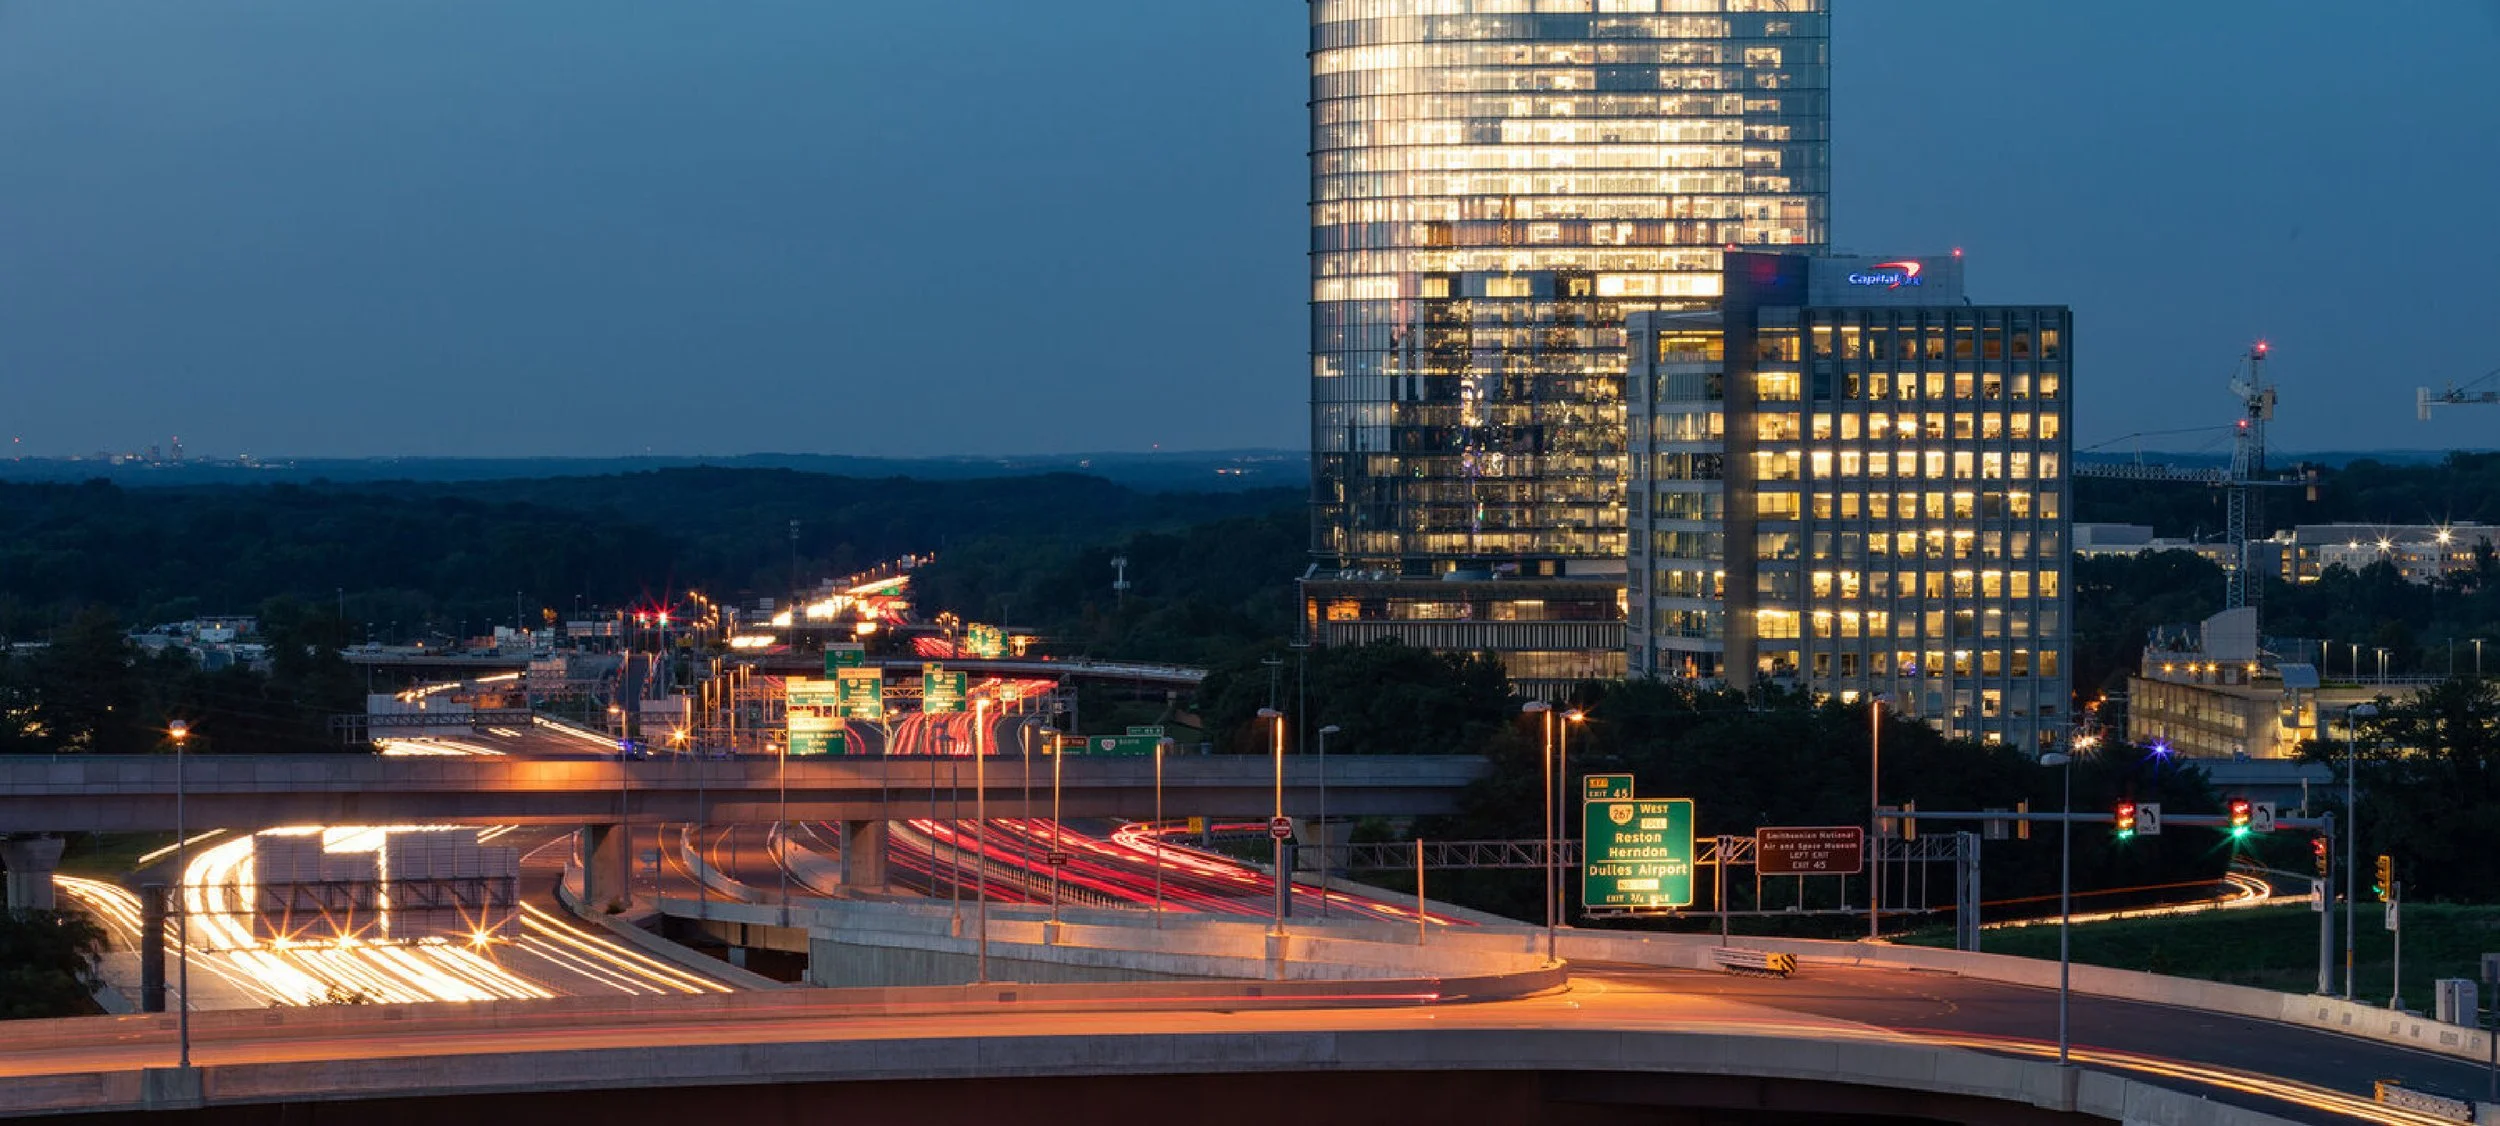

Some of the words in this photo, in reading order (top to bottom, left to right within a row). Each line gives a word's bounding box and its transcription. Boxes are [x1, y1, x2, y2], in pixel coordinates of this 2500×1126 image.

[1849, 273, 1899, 285] Capital
[1613, 809, 1631, 820] 267
[1615, 833, 1662, 843] Reston
[1609, 846, 1668, 857] Herndon
[1790, 851, 1809, 859] LEFT
[1589, 864, 1632, 876] Dulles
[1638, 863, 1687, 877] Airport
[1792, 861, 1809, 869] EXIT
[1606, 894, 1625, 902] EXIT
